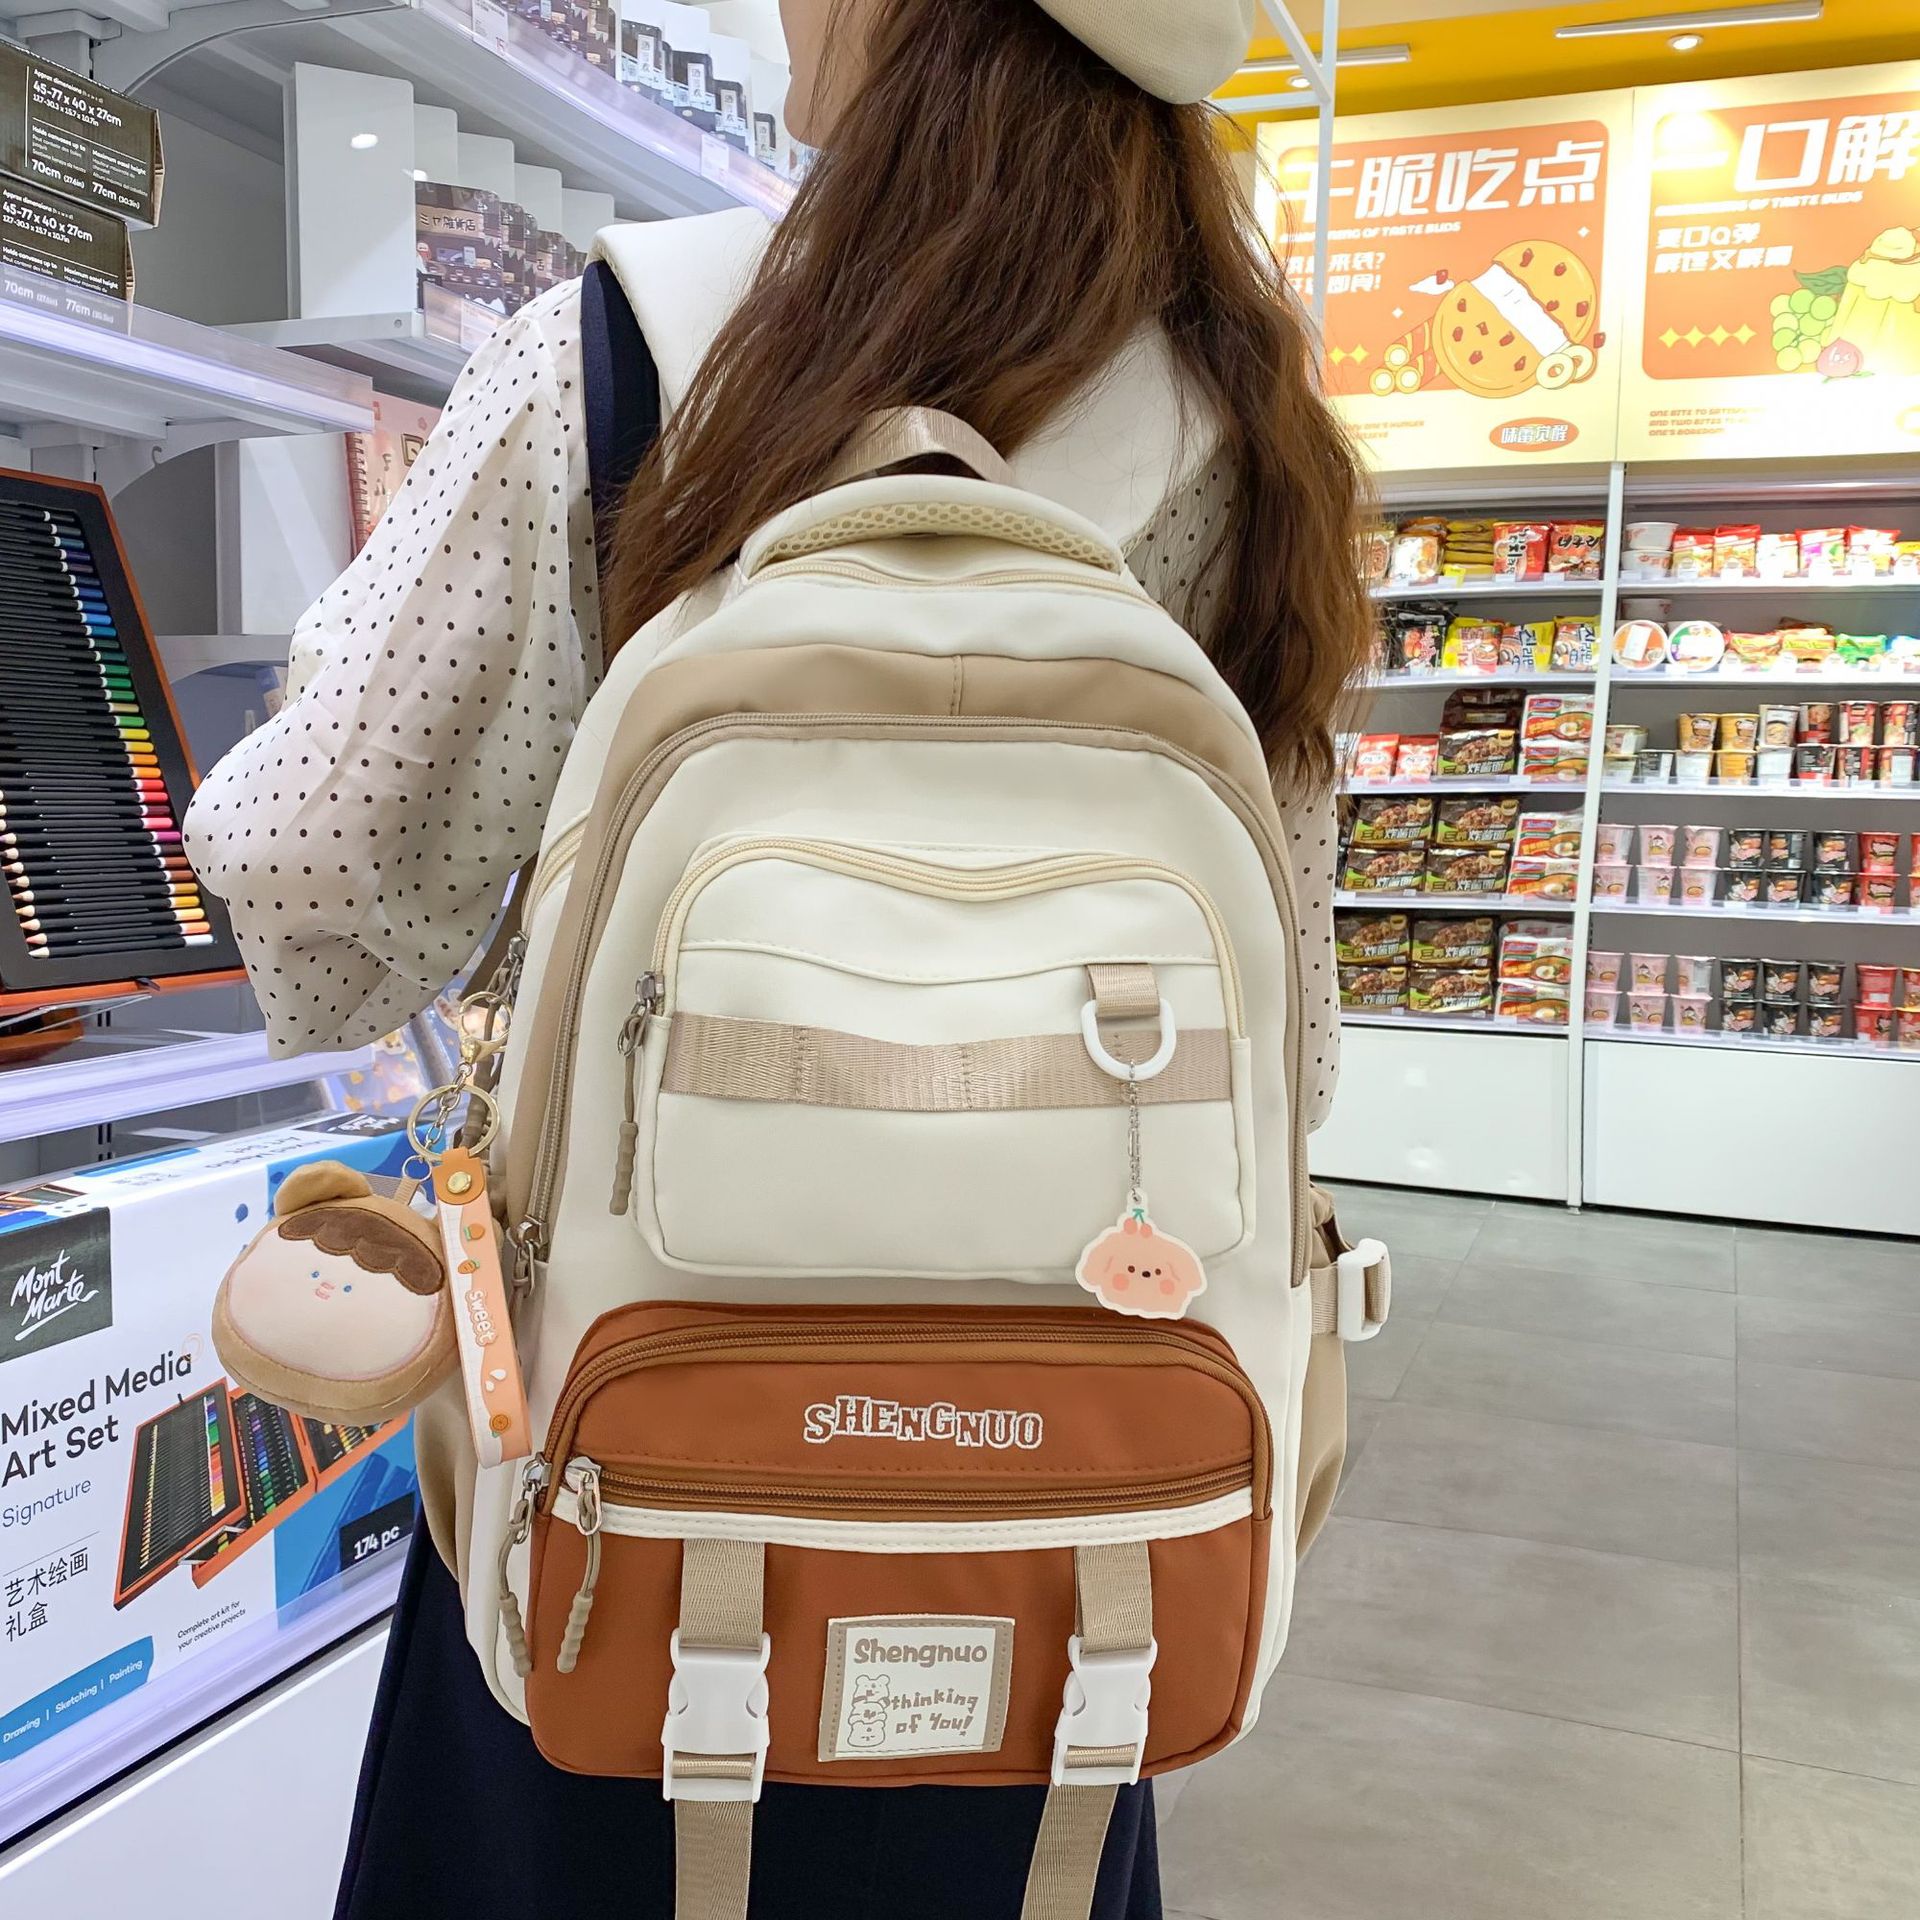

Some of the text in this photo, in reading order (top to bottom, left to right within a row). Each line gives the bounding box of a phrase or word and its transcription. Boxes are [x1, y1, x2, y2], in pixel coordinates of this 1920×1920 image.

[33, 80, 63, 101] 45-77
[64, 96, 70, 105] x
[72, 97, 87, 111] 40
[88, 106, 95, 116] x
[96, 107, 122, 127] 27cm
[31, 158, 62, 179] 70cm
[92, 181, 117, 200] 77cm
[2, 201, 33, 220] 45-77
[33, 213, 40, 223] x
[41, 215, 57, 229] 40
[58, 222, 65, 232] x
[67, 223, 93, 242] 27cm
[4, 280, 34, 299] 70cm
[65, 298, 91, 317] 77cm
[10, 1249, 71, 1307] Mont
[21, 1268, 100, 1326] Marte
[1, 1350, 192, 1445] Mixed Media
[803, 1395, 1045, 1450] SHENGNUO
[1, 1415, 119, 1487] Art Set
[2, 1480, 91, 1528] Signature
[354, 1525, 400, 1560] 174 pc
[4, 1547, 88, 1608] 艺术绘画
[5, 1601, 48, 1642] 礼盒
[177, 1618, 209, 1639] Complete
[178, 1609, 246, 1652] your creative projects
[854, 1638, 987, 1668] Shengnuo
[3, 1659, 143, 1743] Drawing Sketching Painting
[891, 1688, 979, 1714] thinking
[896, 1714, 922, 1734] of
